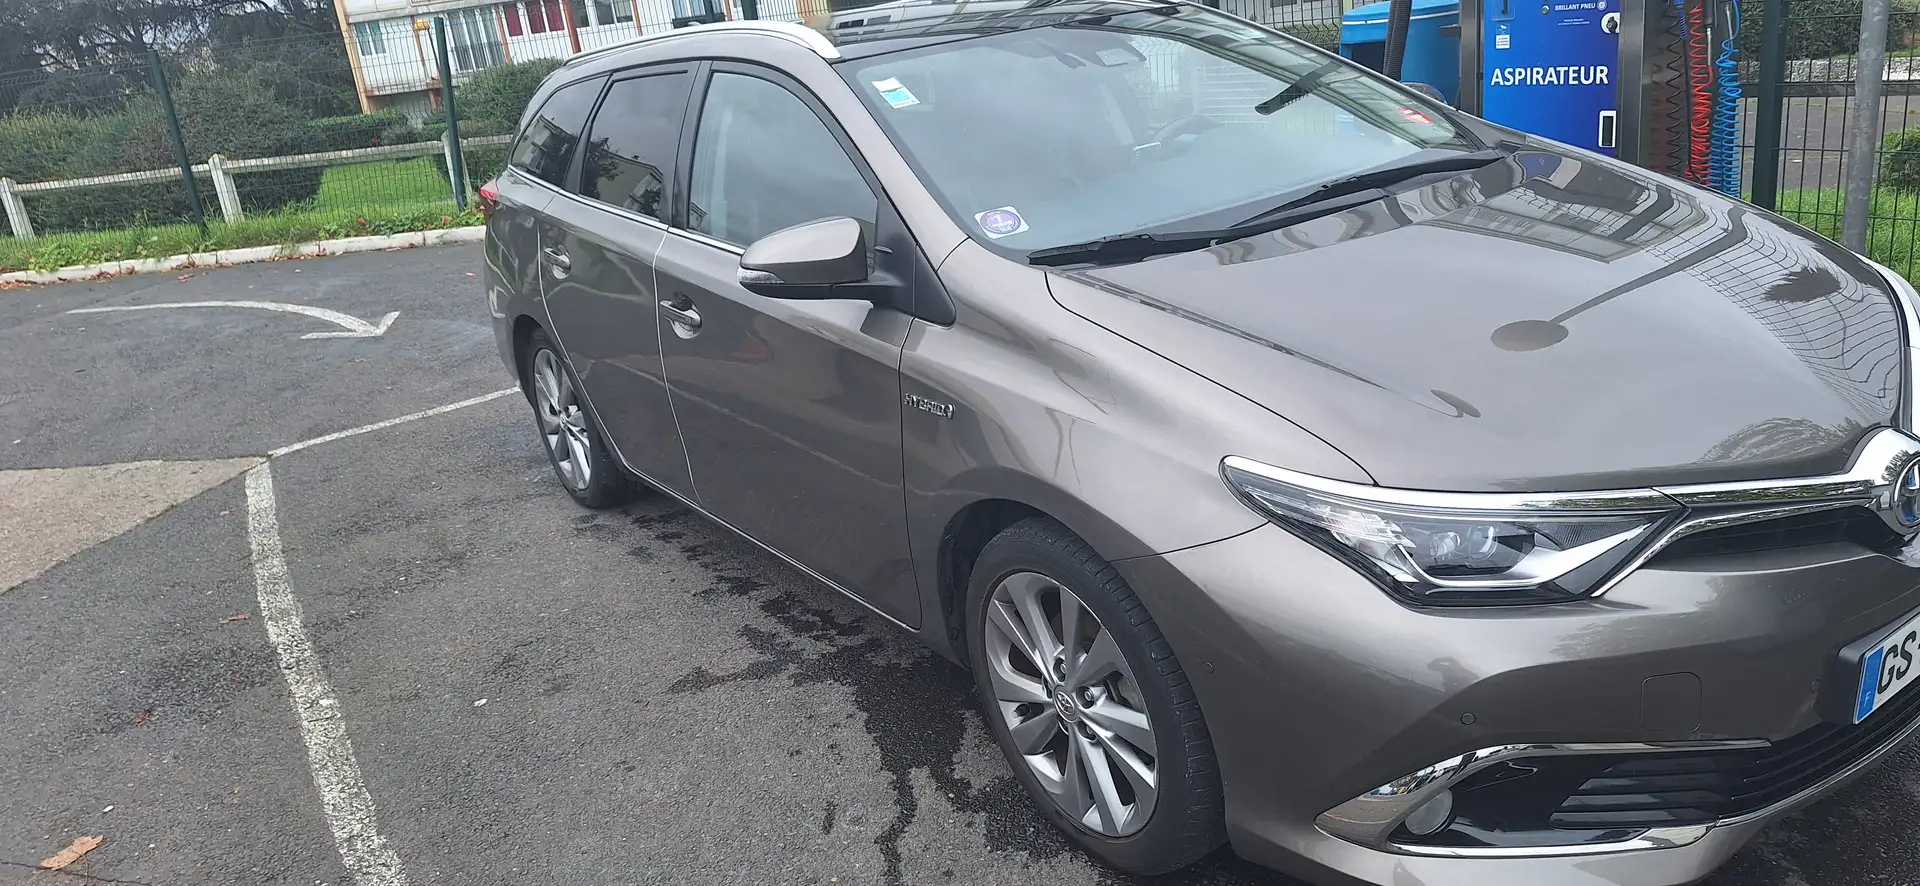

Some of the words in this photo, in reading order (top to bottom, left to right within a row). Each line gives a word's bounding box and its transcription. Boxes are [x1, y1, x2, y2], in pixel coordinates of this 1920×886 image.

[1491, 66, 1609, 86] ASPIRATEUR
[904, 393, 956, 419] HYBRID
[1864, 690, 1872, 707] F
